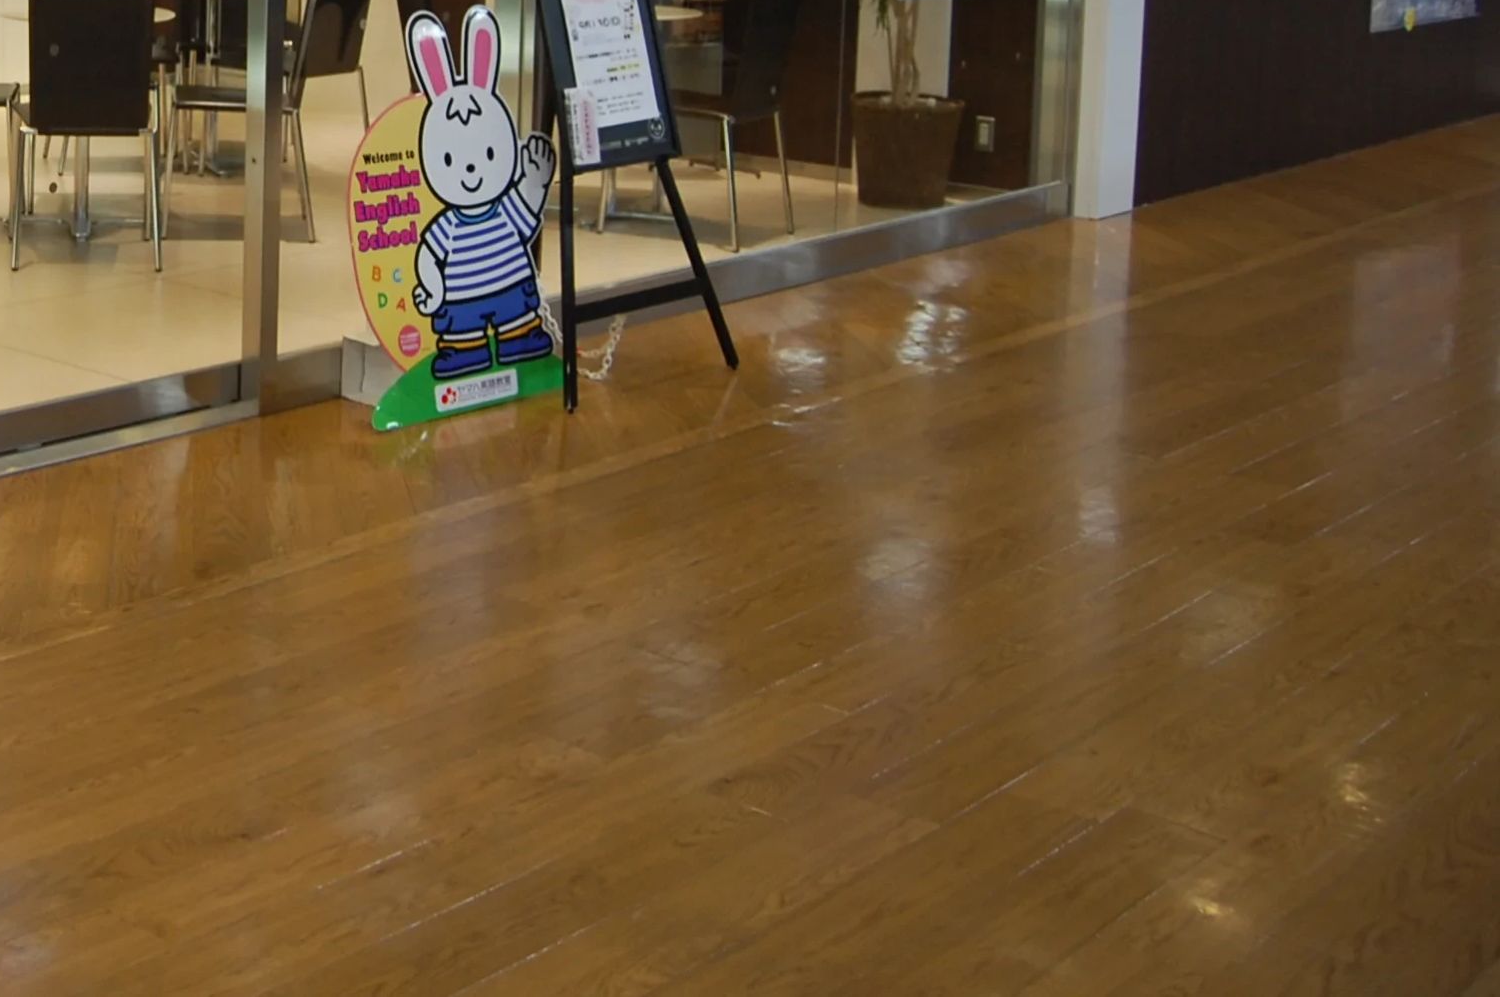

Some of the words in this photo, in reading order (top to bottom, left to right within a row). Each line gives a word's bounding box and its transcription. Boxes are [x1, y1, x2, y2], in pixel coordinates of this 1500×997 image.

[363, 151, 403, 164] Welcome
[405, 150, 415, 160] to
[355, 164, 421, 193] Yamaha
[354, 192, 421, 225] English
[358, 220, 418, 252] School
